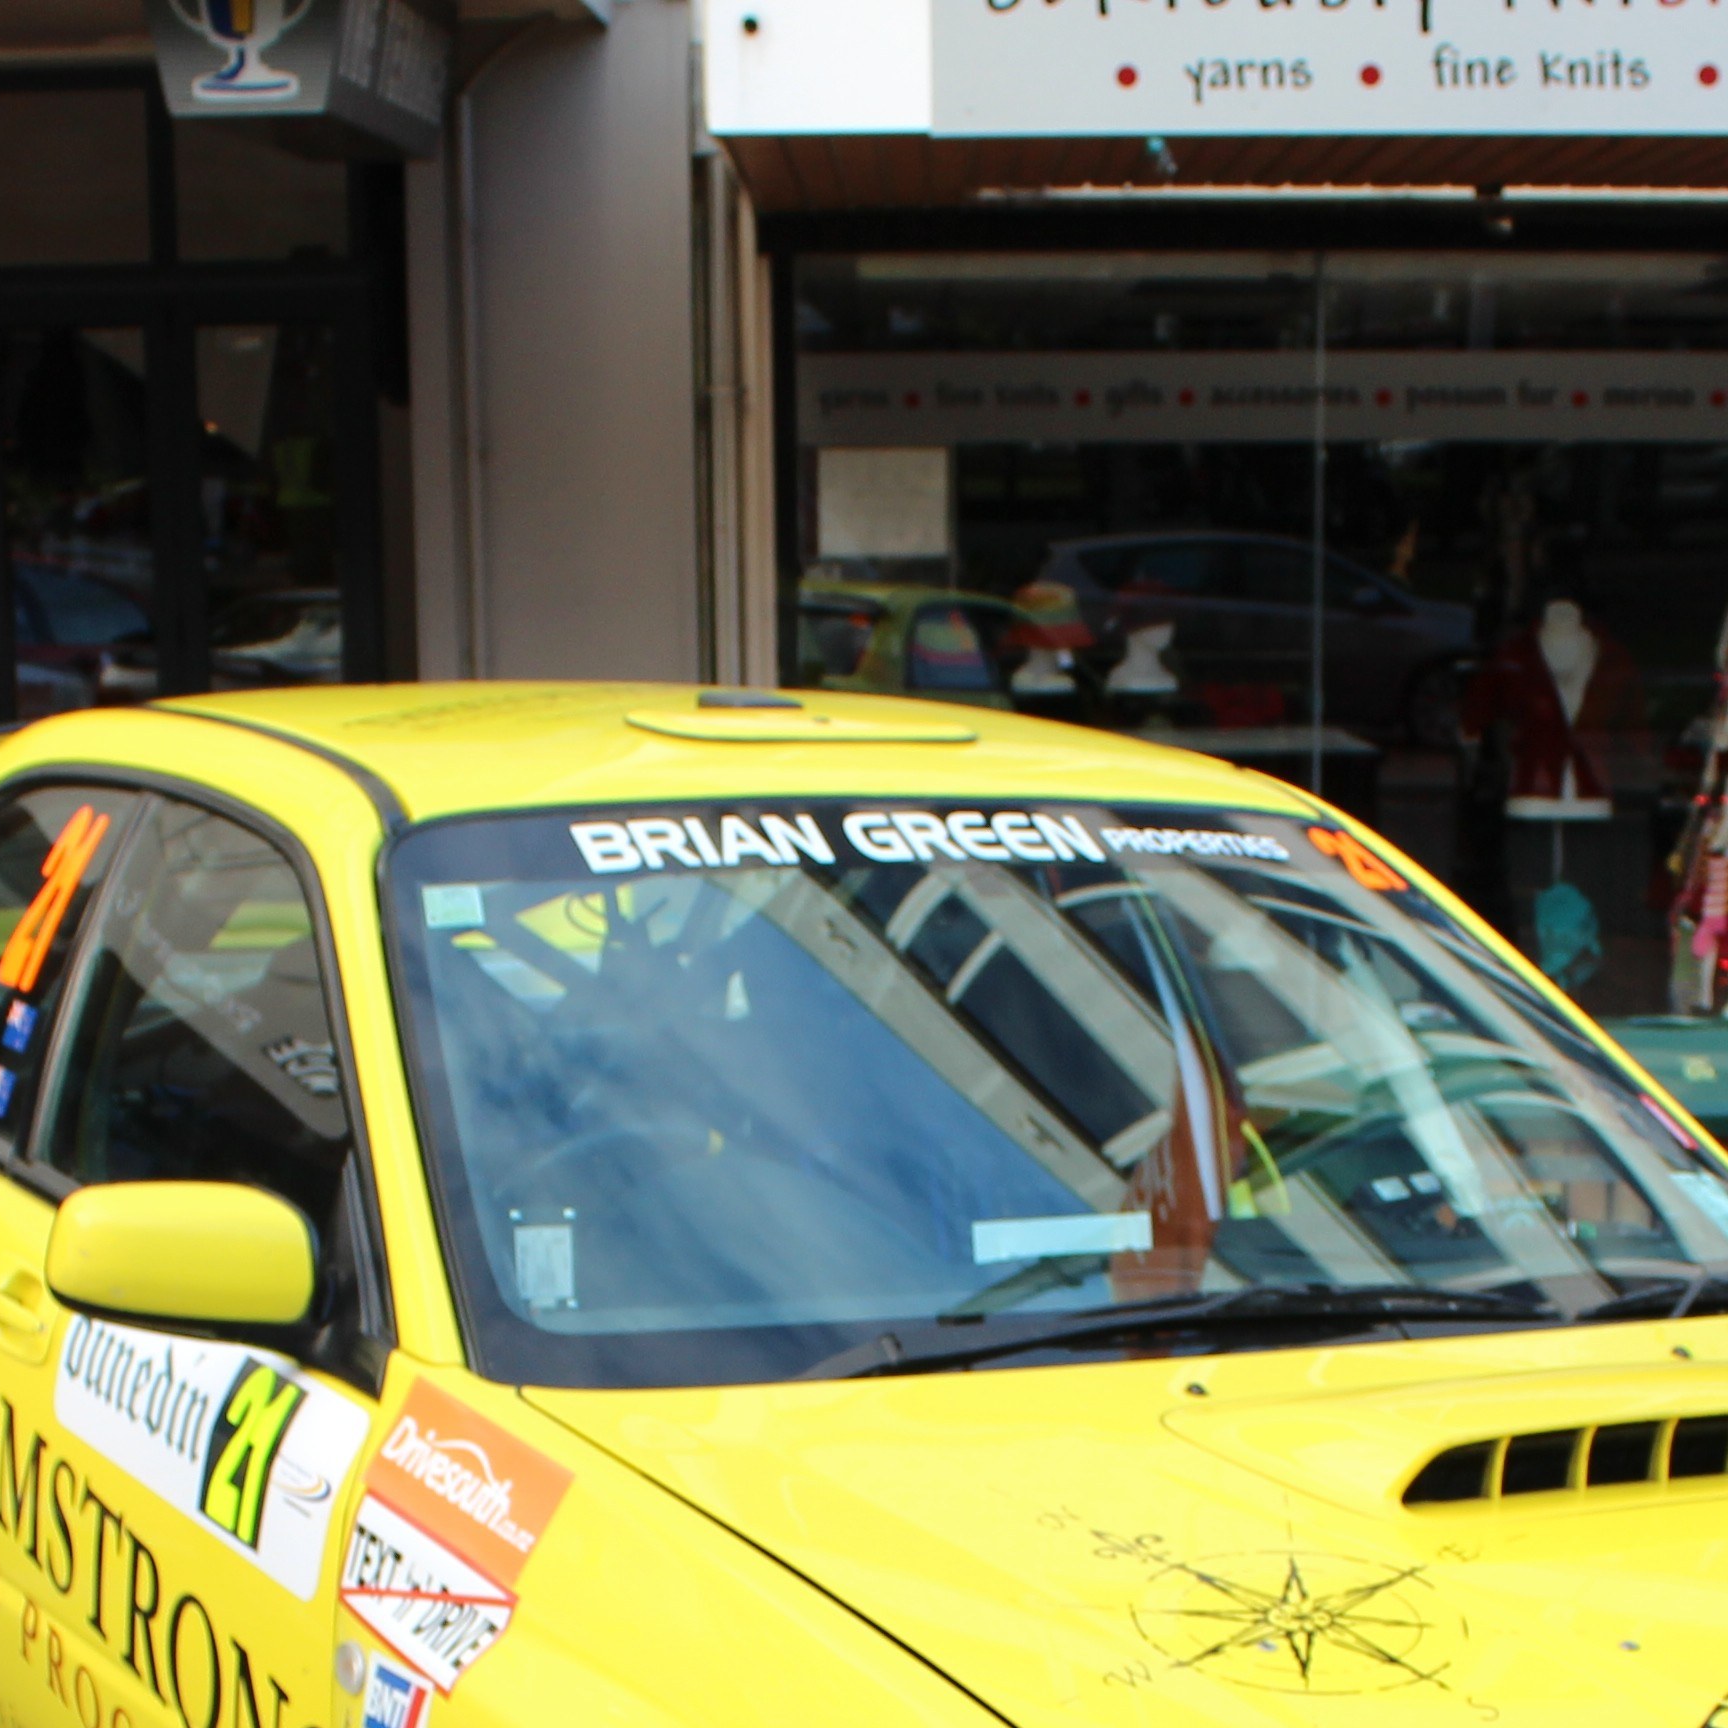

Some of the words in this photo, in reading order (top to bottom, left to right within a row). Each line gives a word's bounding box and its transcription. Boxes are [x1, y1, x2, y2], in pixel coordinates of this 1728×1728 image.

[1185, 53, 1313, 103] yarns
[1434, 41, 1517, 90] fine
[568, 810, 836, 875] BRIAN
[841, 808, 1108, 865] GREEN
[1101, 825, 1290, 863] PROPERTIES
[203, 1364, 305, 1546] 21
[346, 1524, 403, 1607] TEXT
[411, 1580, 499, 1671] DRIVE
